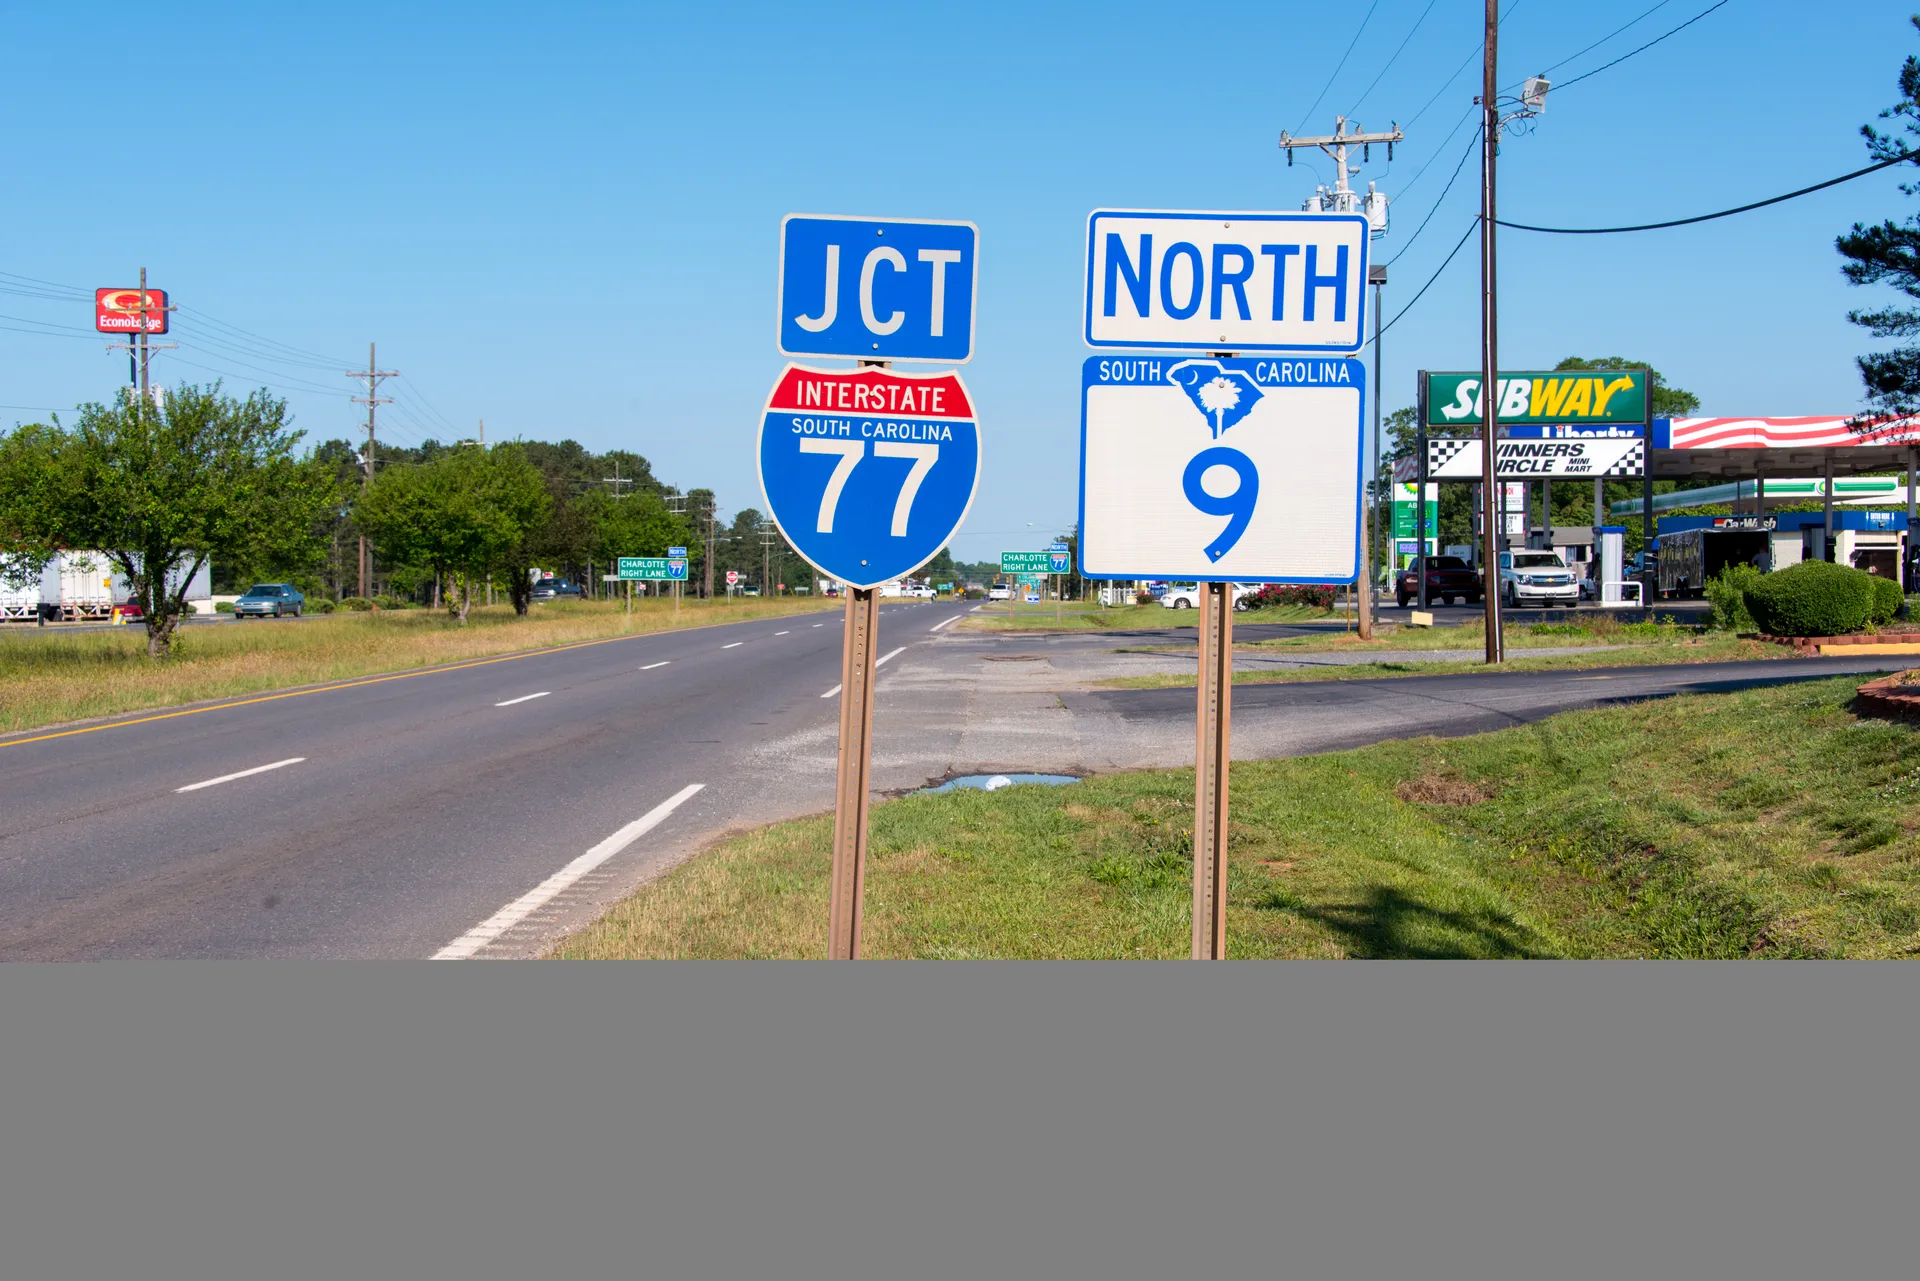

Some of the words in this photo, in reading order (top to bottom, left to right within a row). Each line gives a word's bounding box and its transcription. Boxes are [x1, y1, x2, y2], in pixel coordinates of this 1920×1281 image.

[1103, 232, 1349, 322] NORTH
[794, 244, 961, 337] JCT
[1099, 360, 1161, 382] SOUTH
[1255, 361, 1350, 384] CAROLINA
[797, 380, 946, 413] INTERSTATE
[792, 418, 851, 436] SOUTH
[861, 421, 953, 441] CAROLINA
[1496, 443, 1585, 457] INNERS
[1496, 459, 1555, 473] IRCLE
[1564, 465, 1592, 473] MART
[799, 437, 940, 537] 77
[1182, 446, 1260, 564] 9
[1723, 517, 1776, 529] CarWsh
[621, 560, 666, 568] CHARLOTTE
[1003, 554, 1048, 562] CHARLOTTE
[1053, 559, 1065, 568] 77
[670, 565, 683, 575] 77
[1003, 563, 1025, 571] RIGHT
[1027, 563, 1049, 571] LANE
